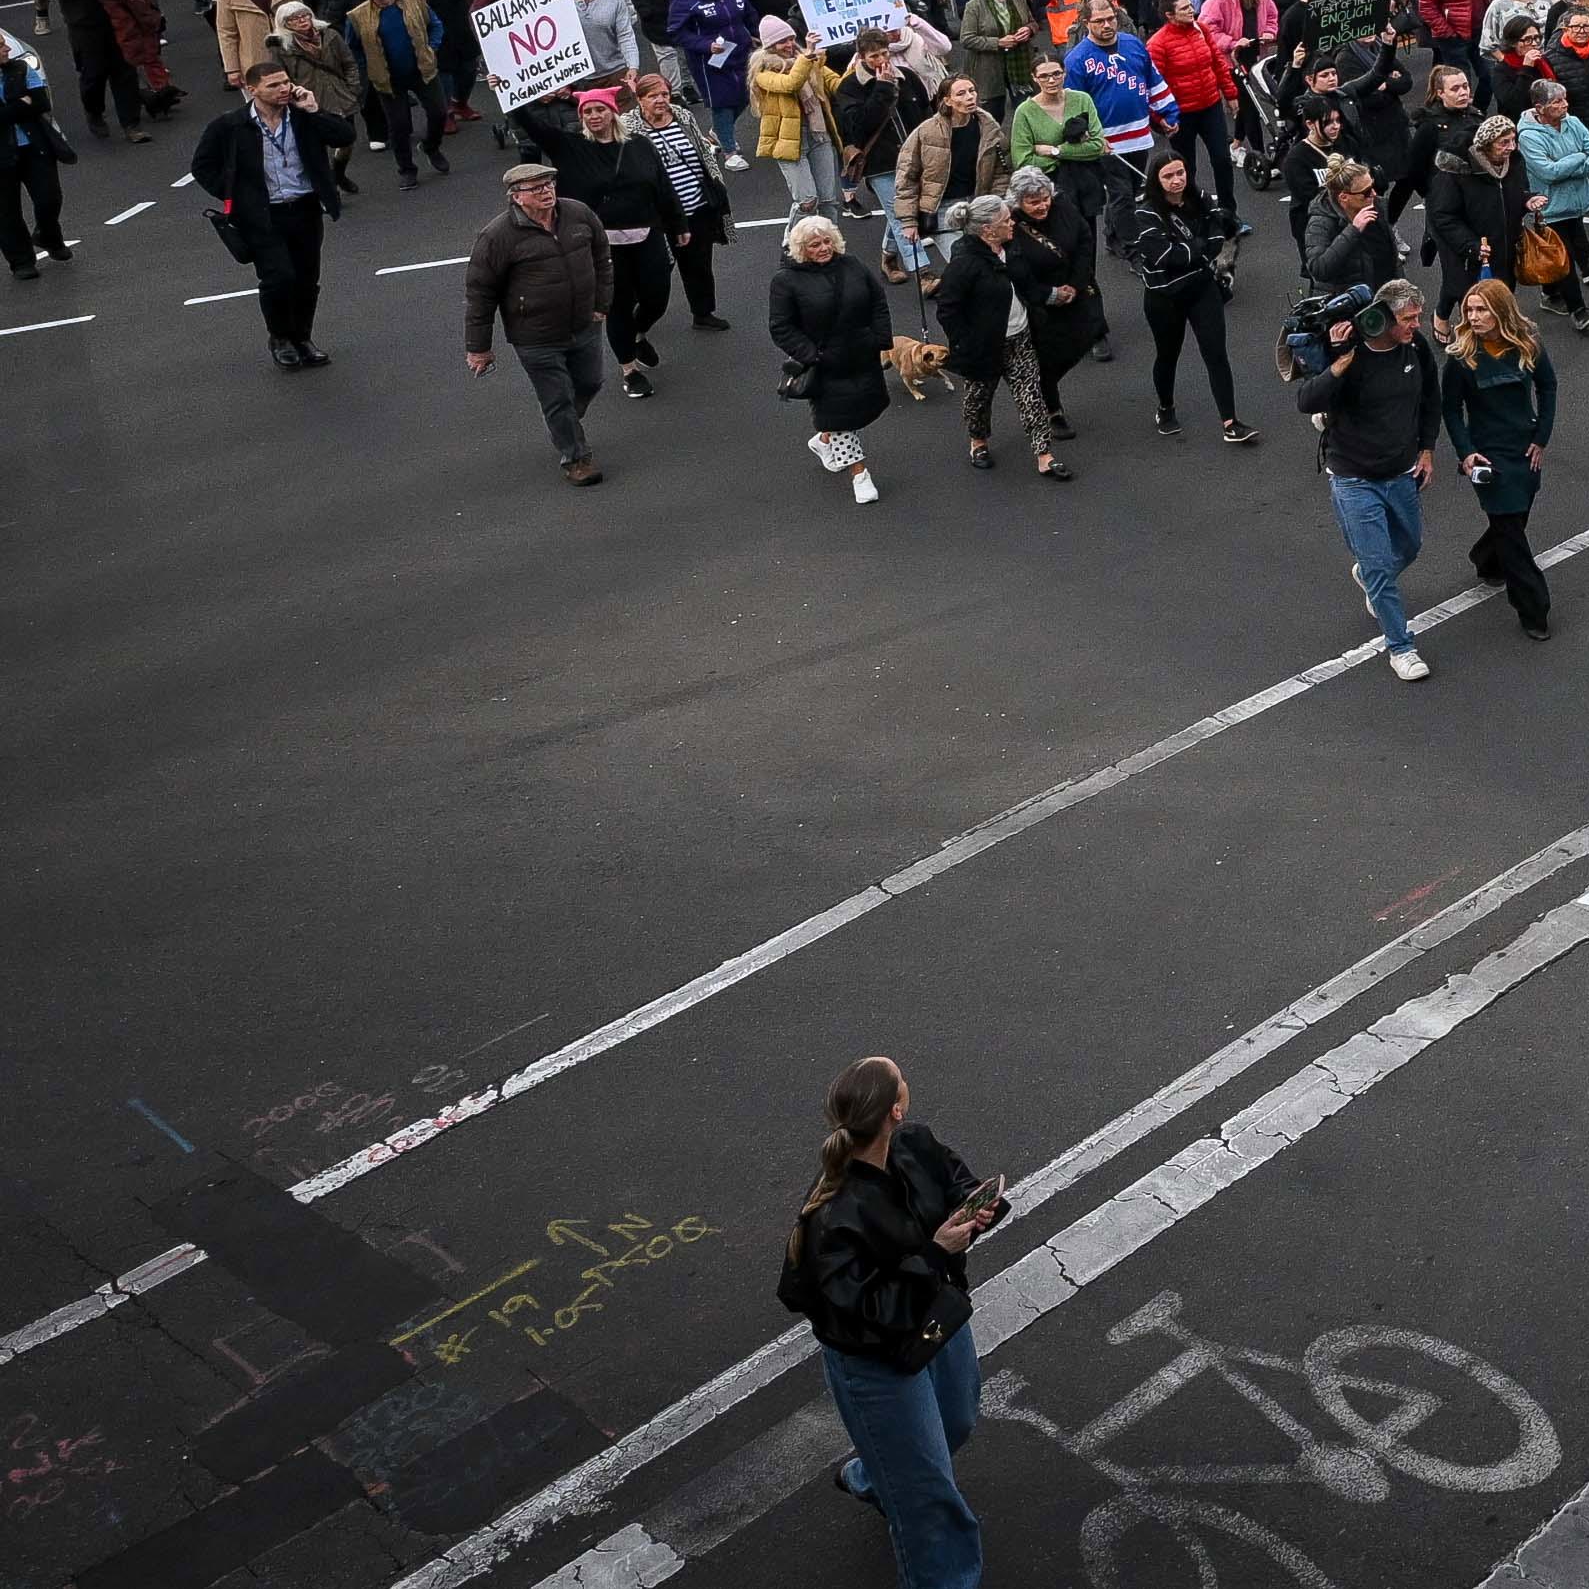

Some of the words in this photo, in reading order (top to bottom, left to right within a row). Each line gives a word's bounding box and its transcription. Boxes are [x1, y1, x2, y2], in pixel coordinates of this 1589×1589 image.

[1320, 4, 1339, 16] PART
[1340, 0, 1351, 10] OF
[1320, 3, 1373, 29] ENOUGH
[508, 15, 557, 65] NO
[826, 14, 891, 41] NIGHT!
[1317, 22, 1376, 51] ENOUGH
[1340, 20, 1351, 32] IS
[516, 41, 582, 83] VIOLENCE
[508, 76, 553, 106] AGAINST
[553, 57, 590, 84] WOMEN
